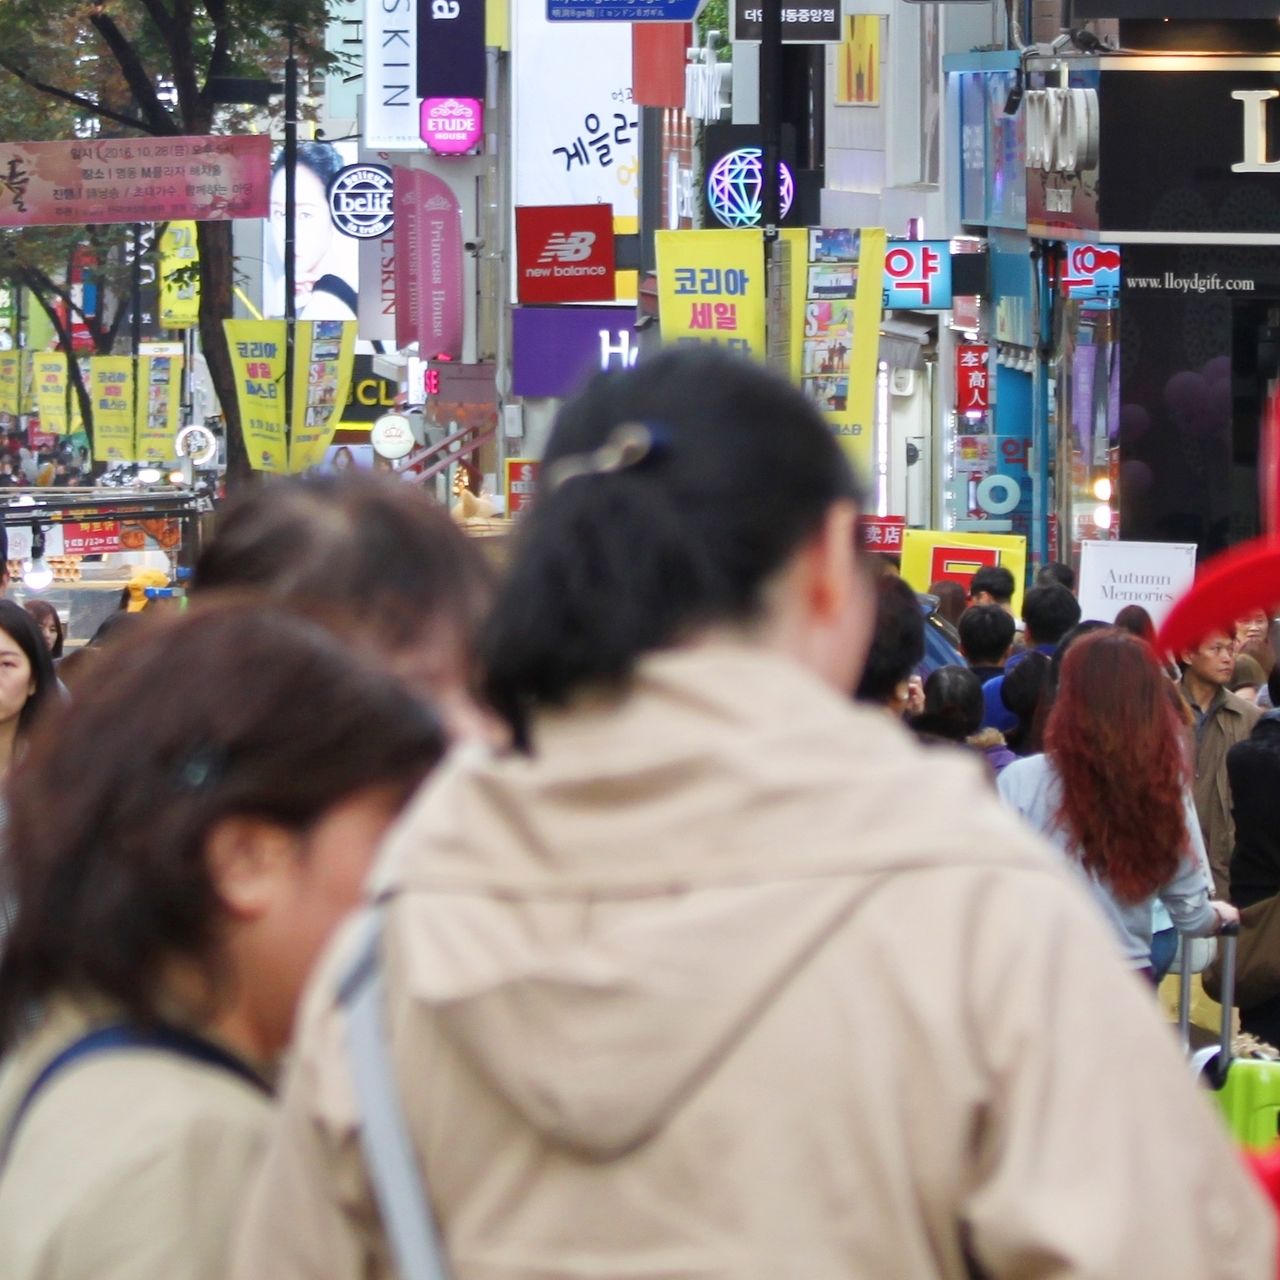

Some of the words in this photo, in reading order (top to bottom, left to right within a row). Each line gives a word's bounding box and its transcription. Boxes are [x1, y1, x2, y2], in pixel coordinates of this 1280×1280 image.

[427, 118, 476, 132] ETUDE
[434, 133, 467, 141] HOUSE
[339, 193, 394, 213] belif
[431, 220, 445, 285] Princess
[526, 264, 551, 278] new
[553, 264, 607, 278] balance
[884, 246, 941, 306] 약
[673, 268, 750, 296] 코리아
[1127, 273, 1256, 293] www.lloydgift.com
[432, 287, 446, 338] House
[688, 302, 738, 330] 세일
[1104, 568, 1172, 587] Autumn
[1100, 584, 1175, 603] Memories
